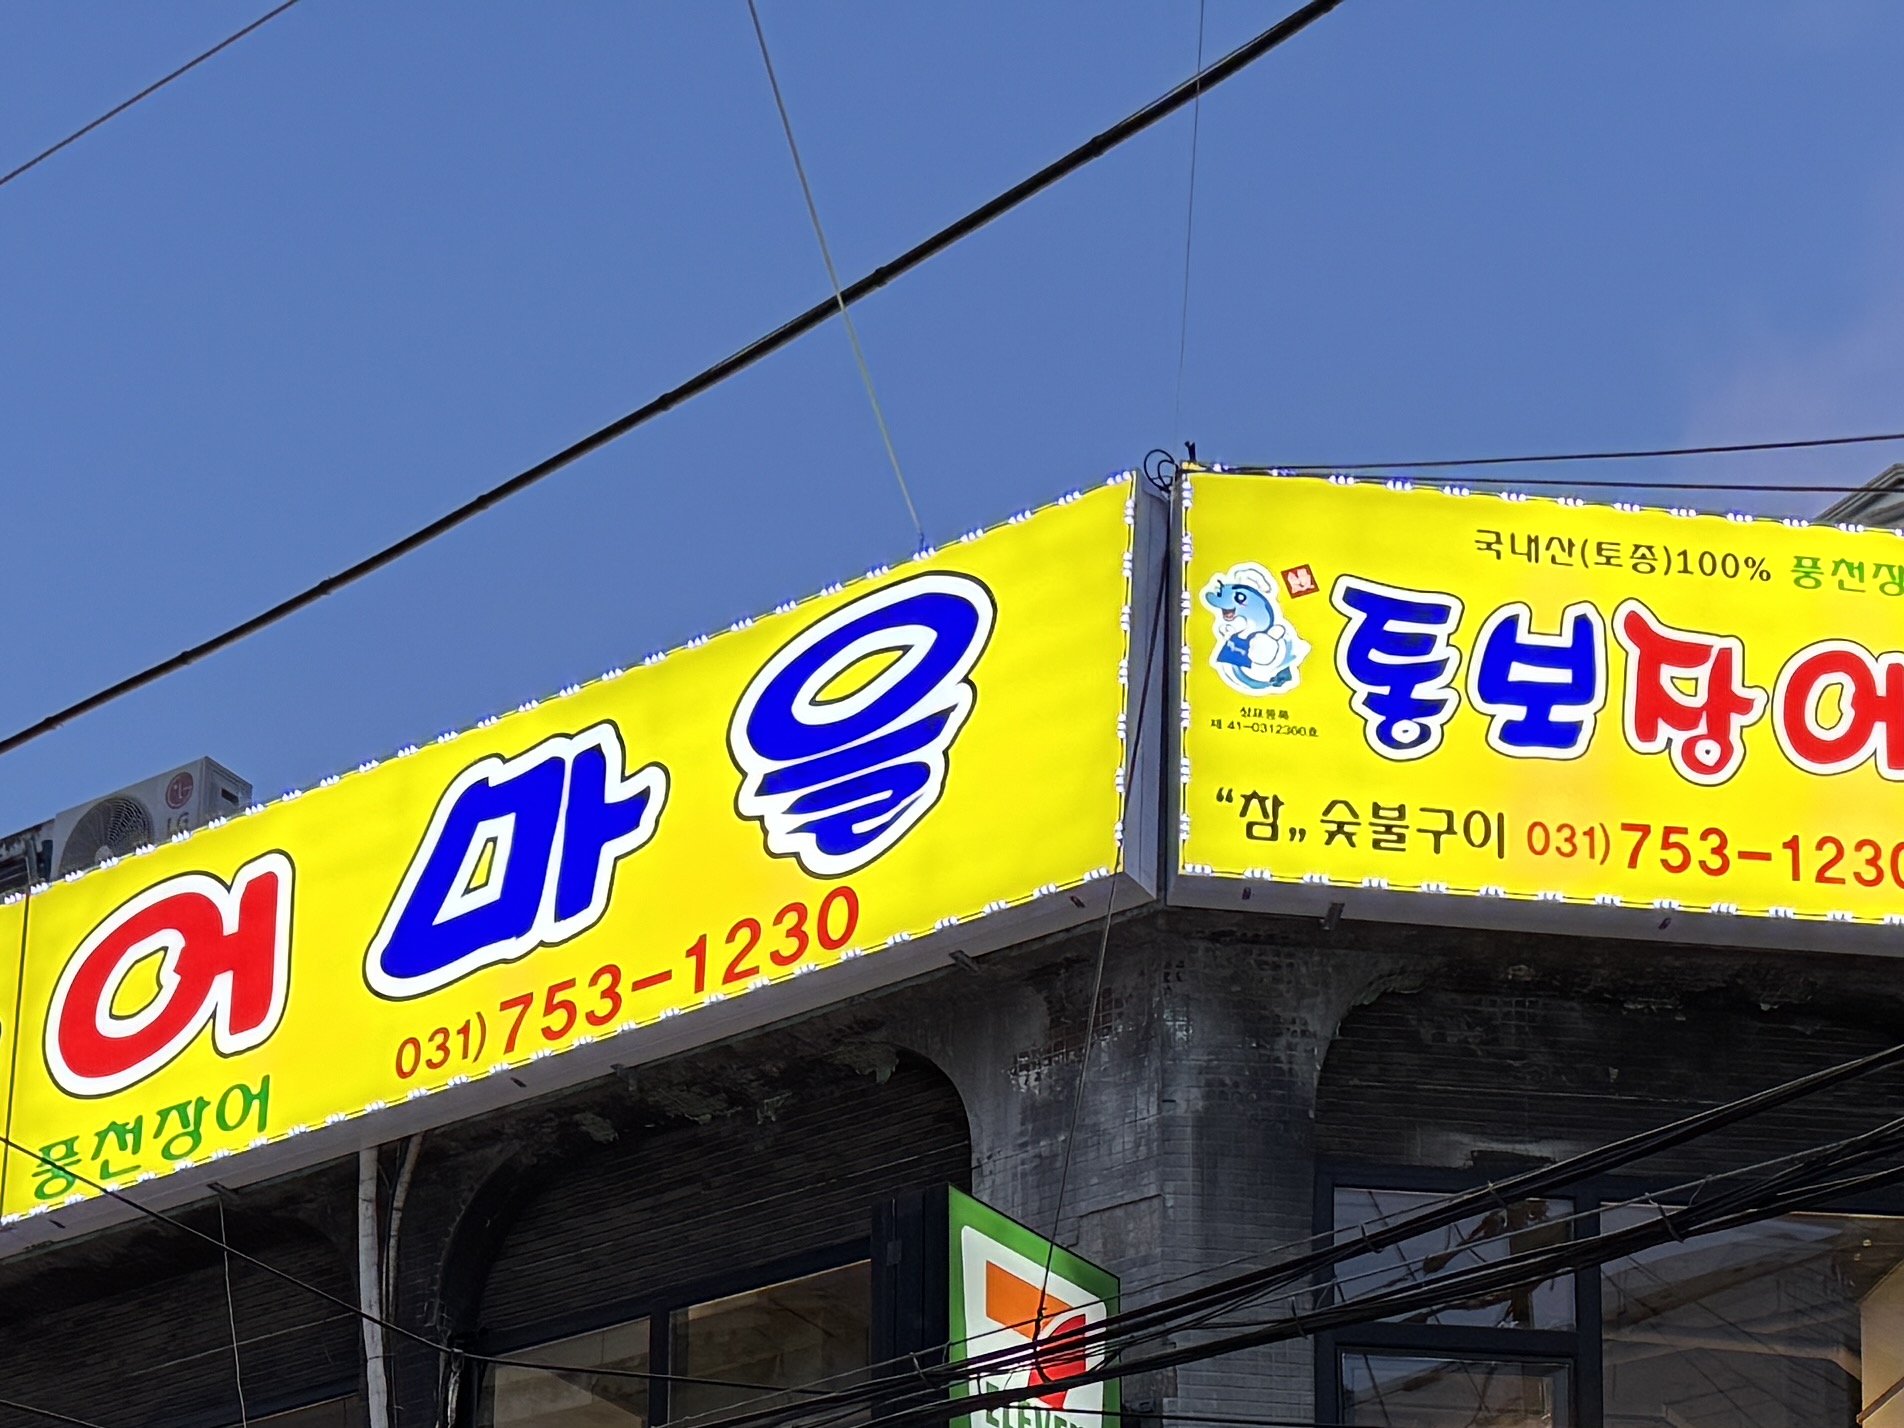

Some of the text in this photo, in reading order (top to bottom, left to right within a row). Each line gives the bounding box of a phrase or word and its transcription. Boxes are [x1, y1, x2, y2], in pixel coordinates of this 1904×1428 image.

[1475, 528, 1772, 583] 국내산(토종)100%
[1319, 798, 1507, 860] 숯불구이
[32, 1073, 272, 1202] 풍천장어
